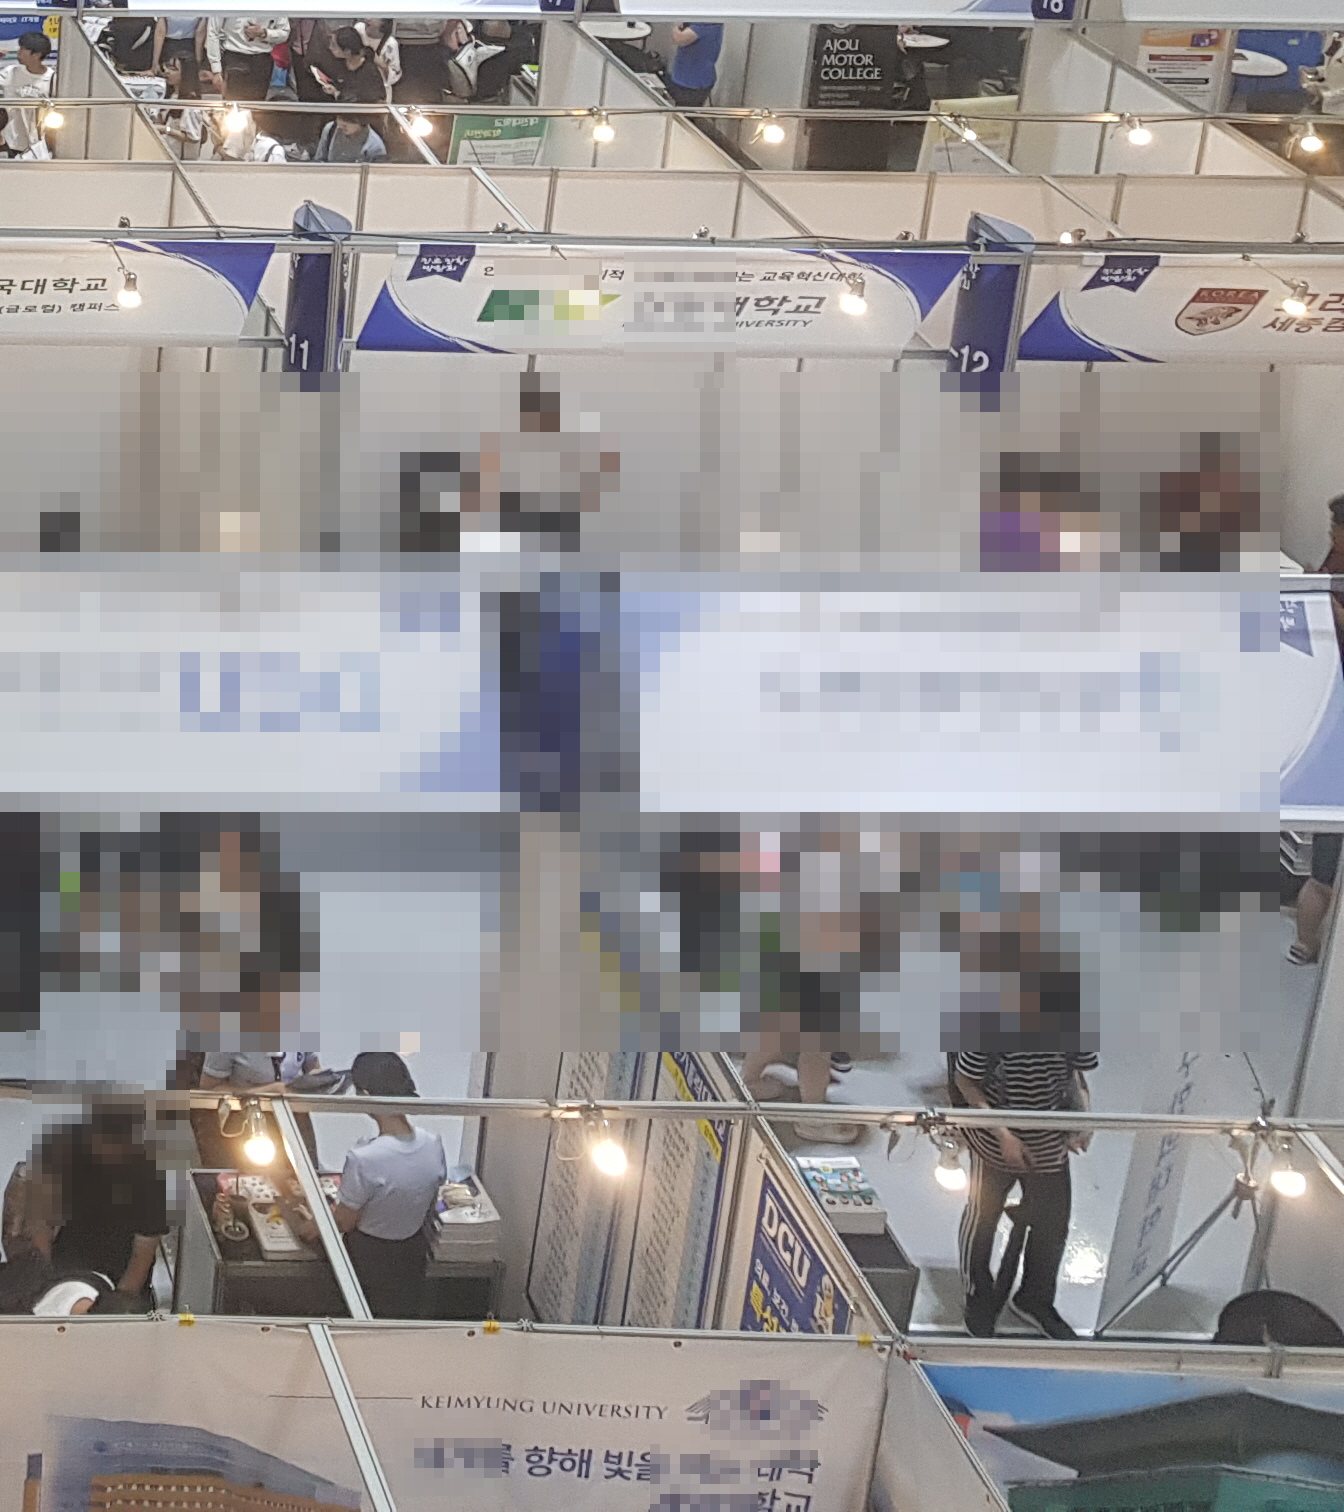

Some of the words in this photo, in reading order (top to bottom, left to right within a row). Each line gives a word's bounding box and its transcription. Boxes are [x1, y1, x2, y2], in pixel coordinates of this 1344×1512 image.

[823, 38, 861, 53] AJOU
[821, 53, 873, 67] MOTOR
[819, 66, 883, 81] COLLEGE
[1198, 289, 1259, 299] KOREA
[761, 1194, 812, 1289] DCU
[420, 1394, 535, 1414] KEIMYUNG
[542, 1399, 669, 1420] UNIVERSITY
[524, 1445, 593, 1480] 향해
